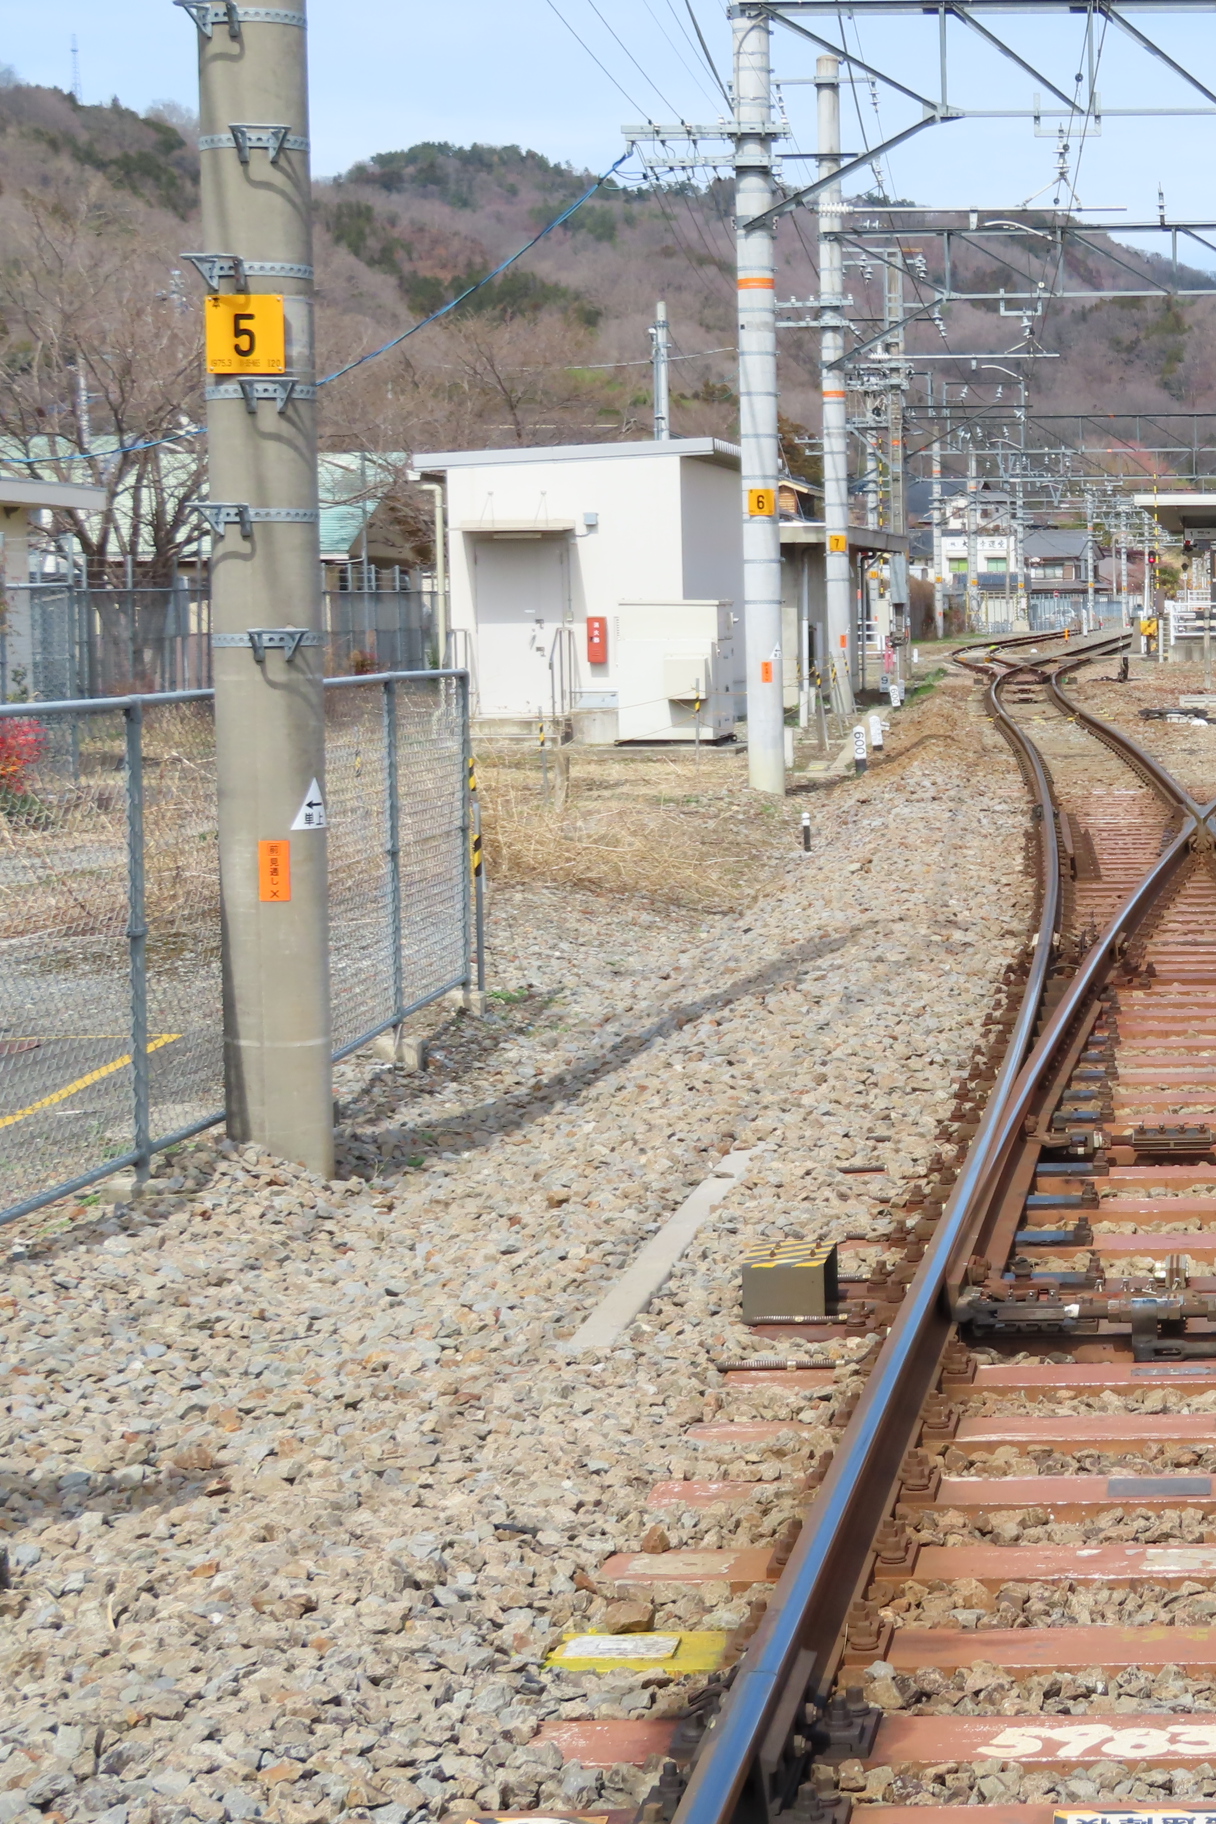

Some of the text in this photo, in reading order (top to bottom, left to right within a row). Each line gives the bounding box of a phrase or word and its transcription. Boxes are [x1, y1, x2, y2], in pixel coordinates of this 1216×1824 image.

[234, 313, 256, 357] 5
[756, 494, 765, 510] 6
[834, 538, 840, 549] 7
[881, 676, 889, 685] 9
[890, 687, 900, 704] 600
[853, 731, 866, 755] 600
